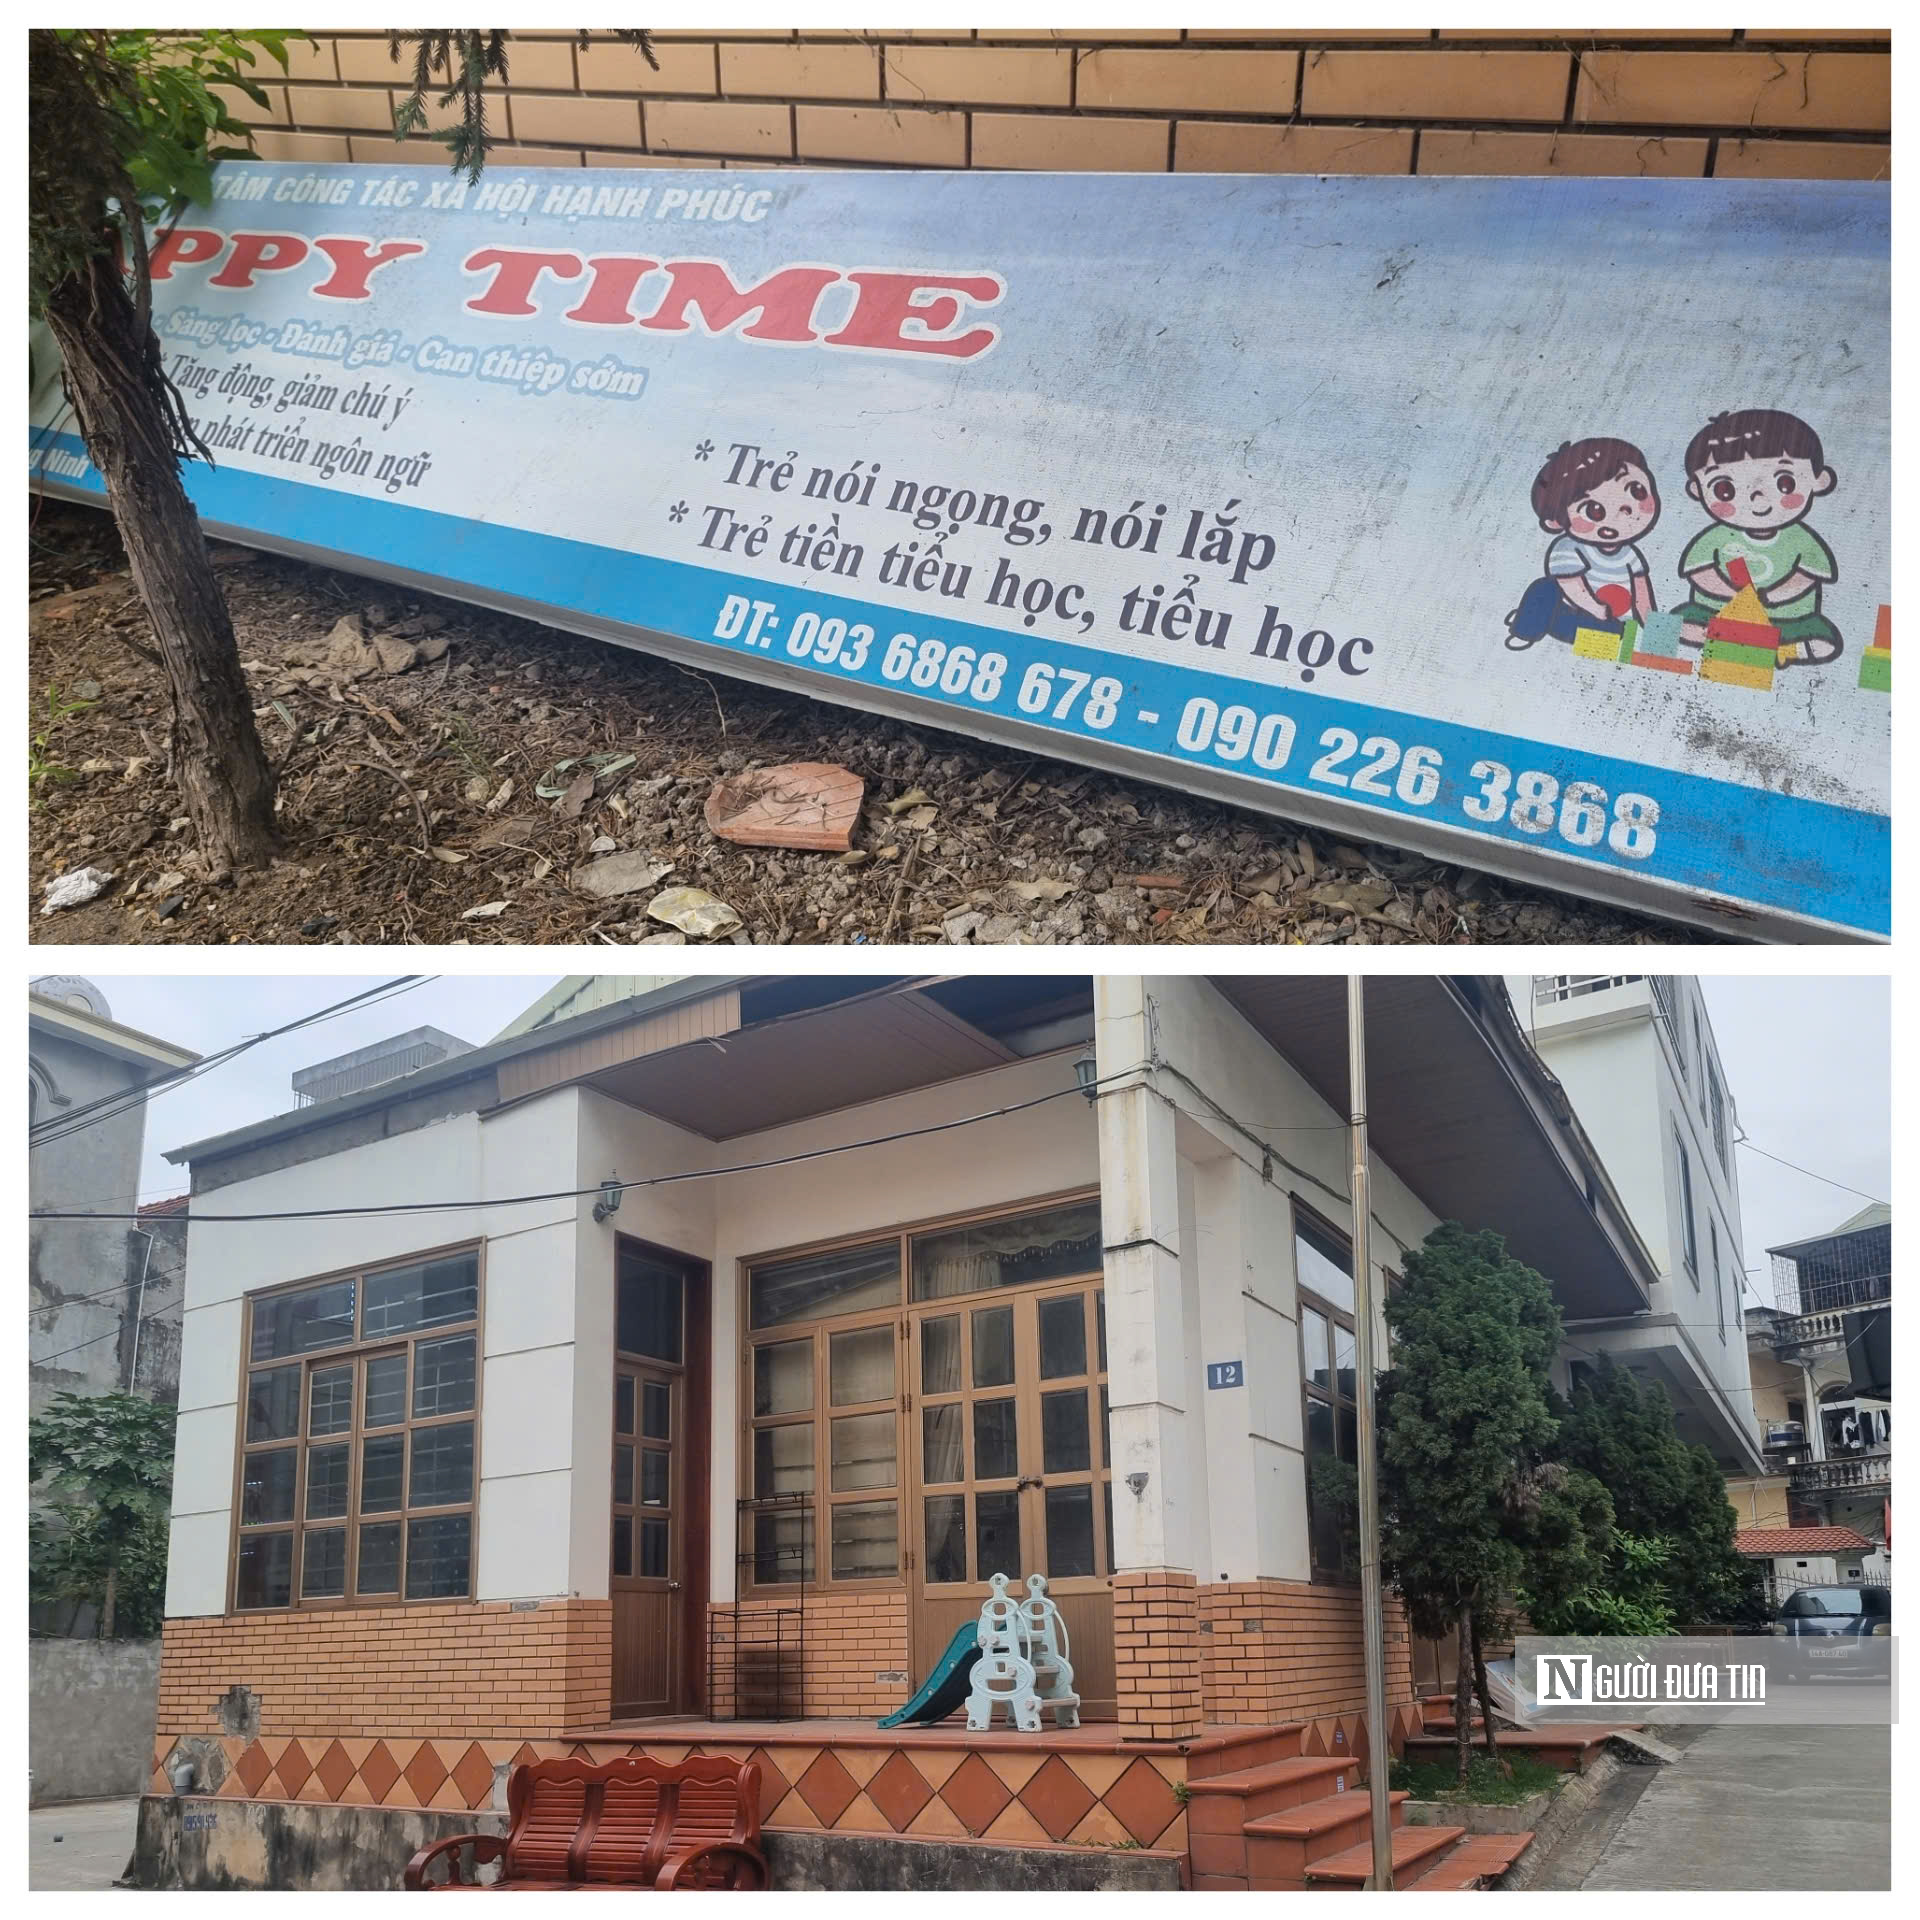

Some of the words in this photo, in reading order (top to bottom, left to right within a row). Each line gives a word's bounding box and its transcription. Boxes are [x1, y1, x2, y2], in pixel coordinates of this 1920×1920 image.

[273, 174, 354, 205] CÔNG
[358, 175, 420, 208] TÁC
[421, 177, 470, 209] XÃ
[473, 177, 539, 218] HỘI
[541, 184, 652, 222] HẠNH
[655, 183, 773, 222] PHÚC
[120, 227, 425, 300] PPY
[464, 249, 1001, 359] TIME
[169, 354, 219, 399] Tăng
[218, 362, 274, 409] động,
[274, 372, 338, 413] giảm
[340, 382, 391, 419] chú
[382, 387, 414, 431] ý
[222, 317, 262, 350] lọc
[277, 322, 346, 357] Đánh
[347, 334, 398, 364] giá
[417, 340, 474, 372] Can
[480, 346, 567, 390] thiệp
[572, 360, 644, 396] sớm
[46, 448, 90, 479] Ninh
[201, 414, 256, 451] phát
[252, 417, 309, 463] triển
[309, 436, 373, 480] ngôn
[374, 452, 432, 493] ngữ
[723, 443, 798, 492] Trẻ
[802, 459, 881, 506] nói
[885, 479, 1051, 547] ngọng,
[1070, 500, 1168, 553] nói
[1177, 499, 1276, 585] lắp
[697, 505, 773, 558] Trẻ
[779, 513, 864, 578] tiền
[878, 531, 972, 599] tiểu
[984, 557, 1095, 634] học,
[1118, 574, 1232, 649] tiểu
[1250, 605, 1374, 682] học
[713, 594, 780, 648] ĐT:
[786, 612, 875, 671] 093
[881, 634, 1008, 702] 6868
[1017, 662, 1123, 729] 678
[1176, 697, 1297, 770] 090
[1309, 727, 1443, 805] 226
[1462, 760, 1661, 860] 3868
[1215, 1365, 1236, 1384] 12
